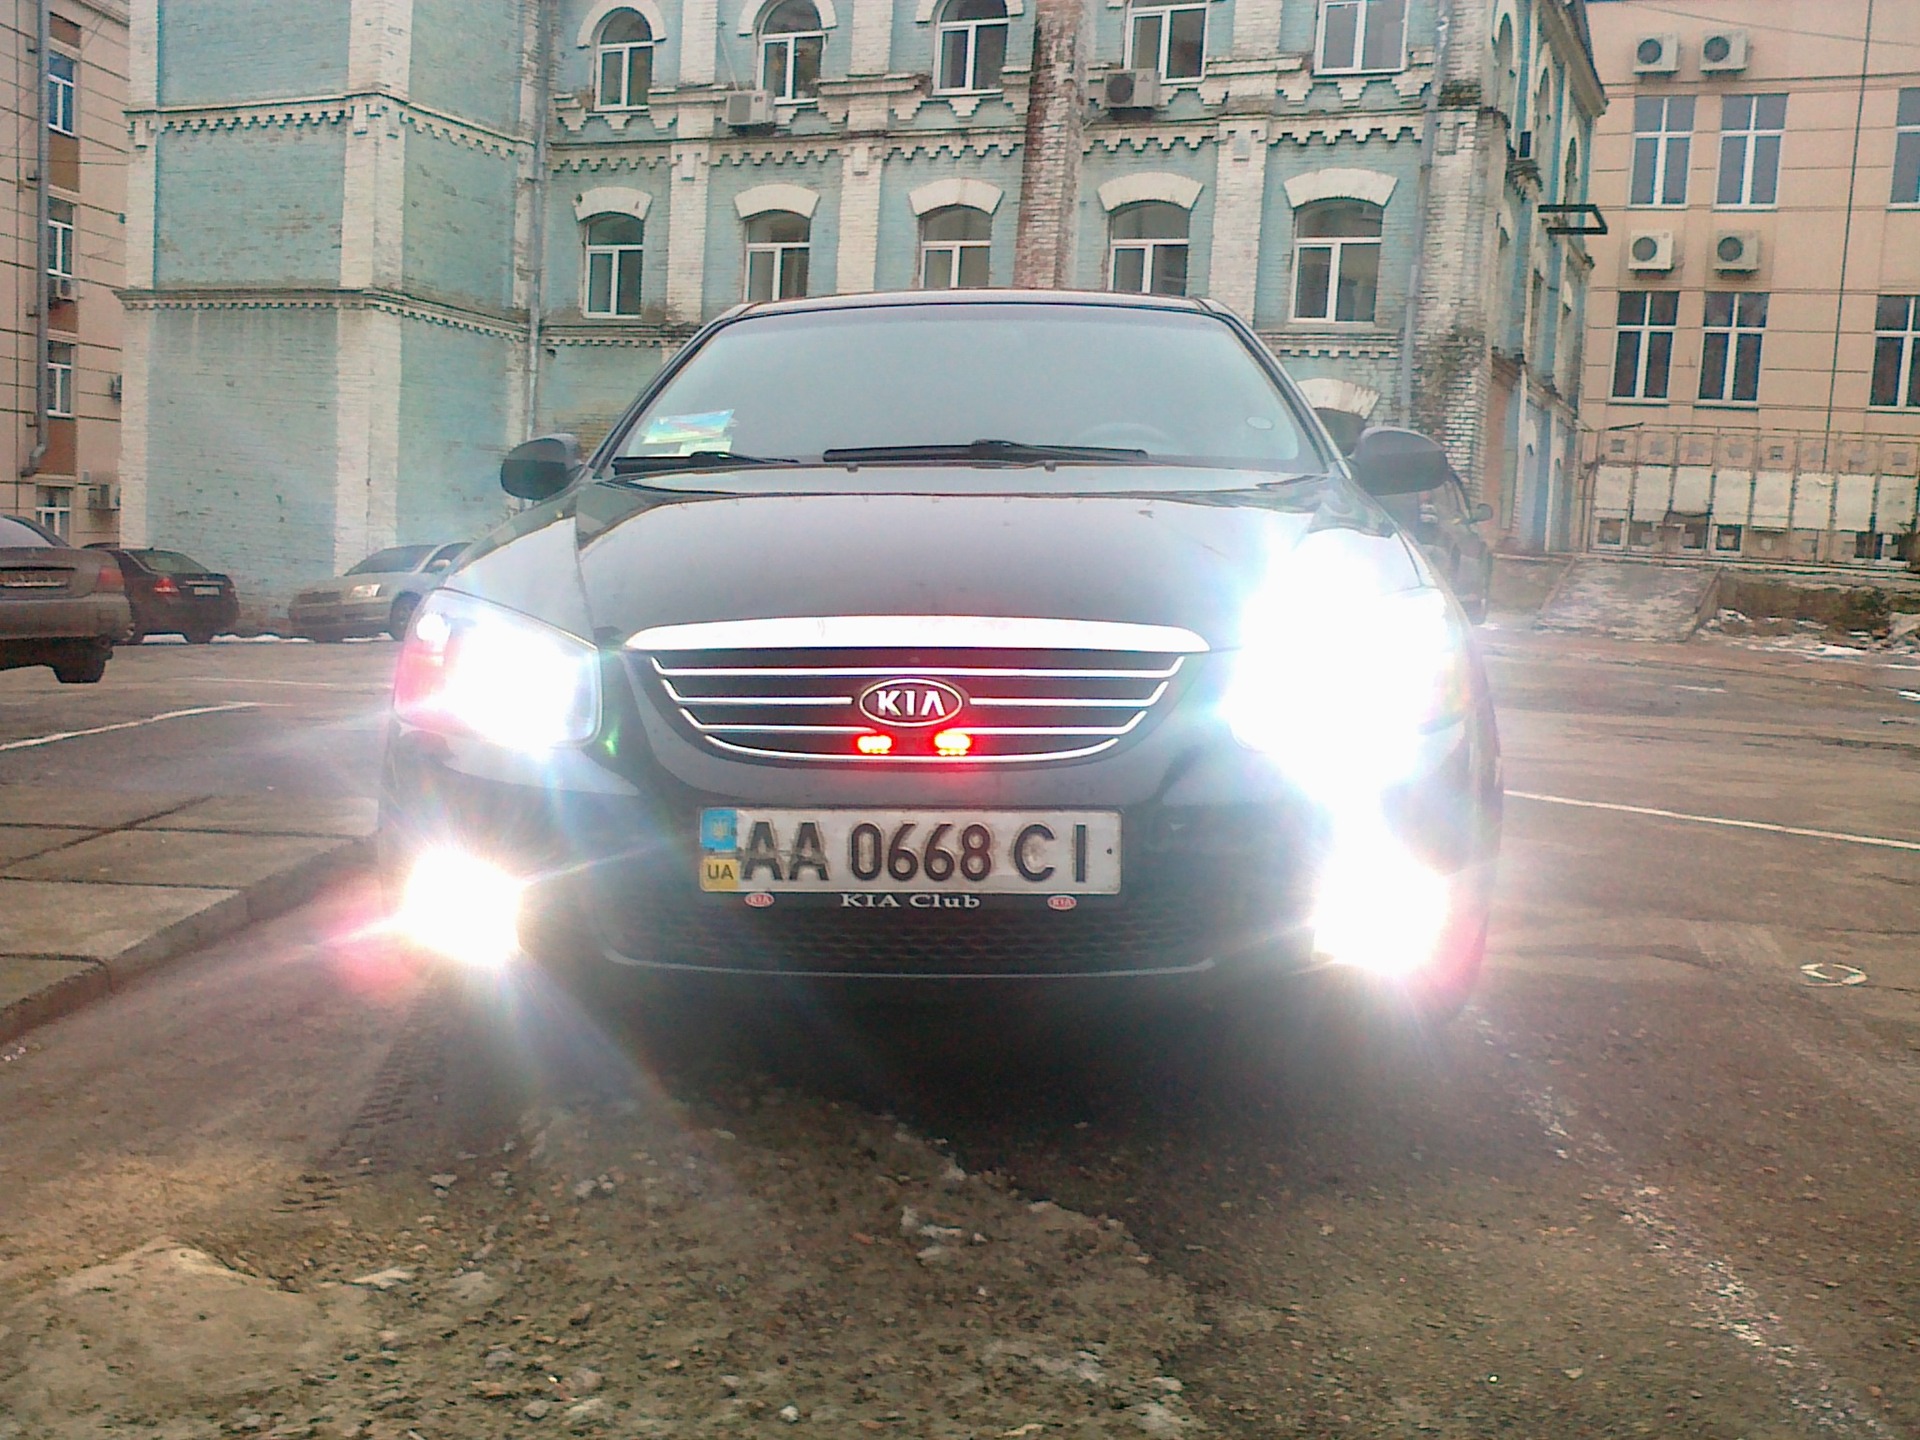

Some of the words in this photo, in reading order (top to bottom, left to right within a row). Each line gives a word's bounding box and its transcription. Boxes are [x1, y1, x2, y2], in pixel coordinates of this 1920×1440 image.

[875, 689, 946, 716] KIA
[741, 820, 830, 881] AA
[850, 821, 992, 882] 0668
[1013, 822, 1087, 883] CI
[706, 863, 735, 881] UA
[840, 892, 902, 908] KIA
[908, 893, 981, 909] Club
